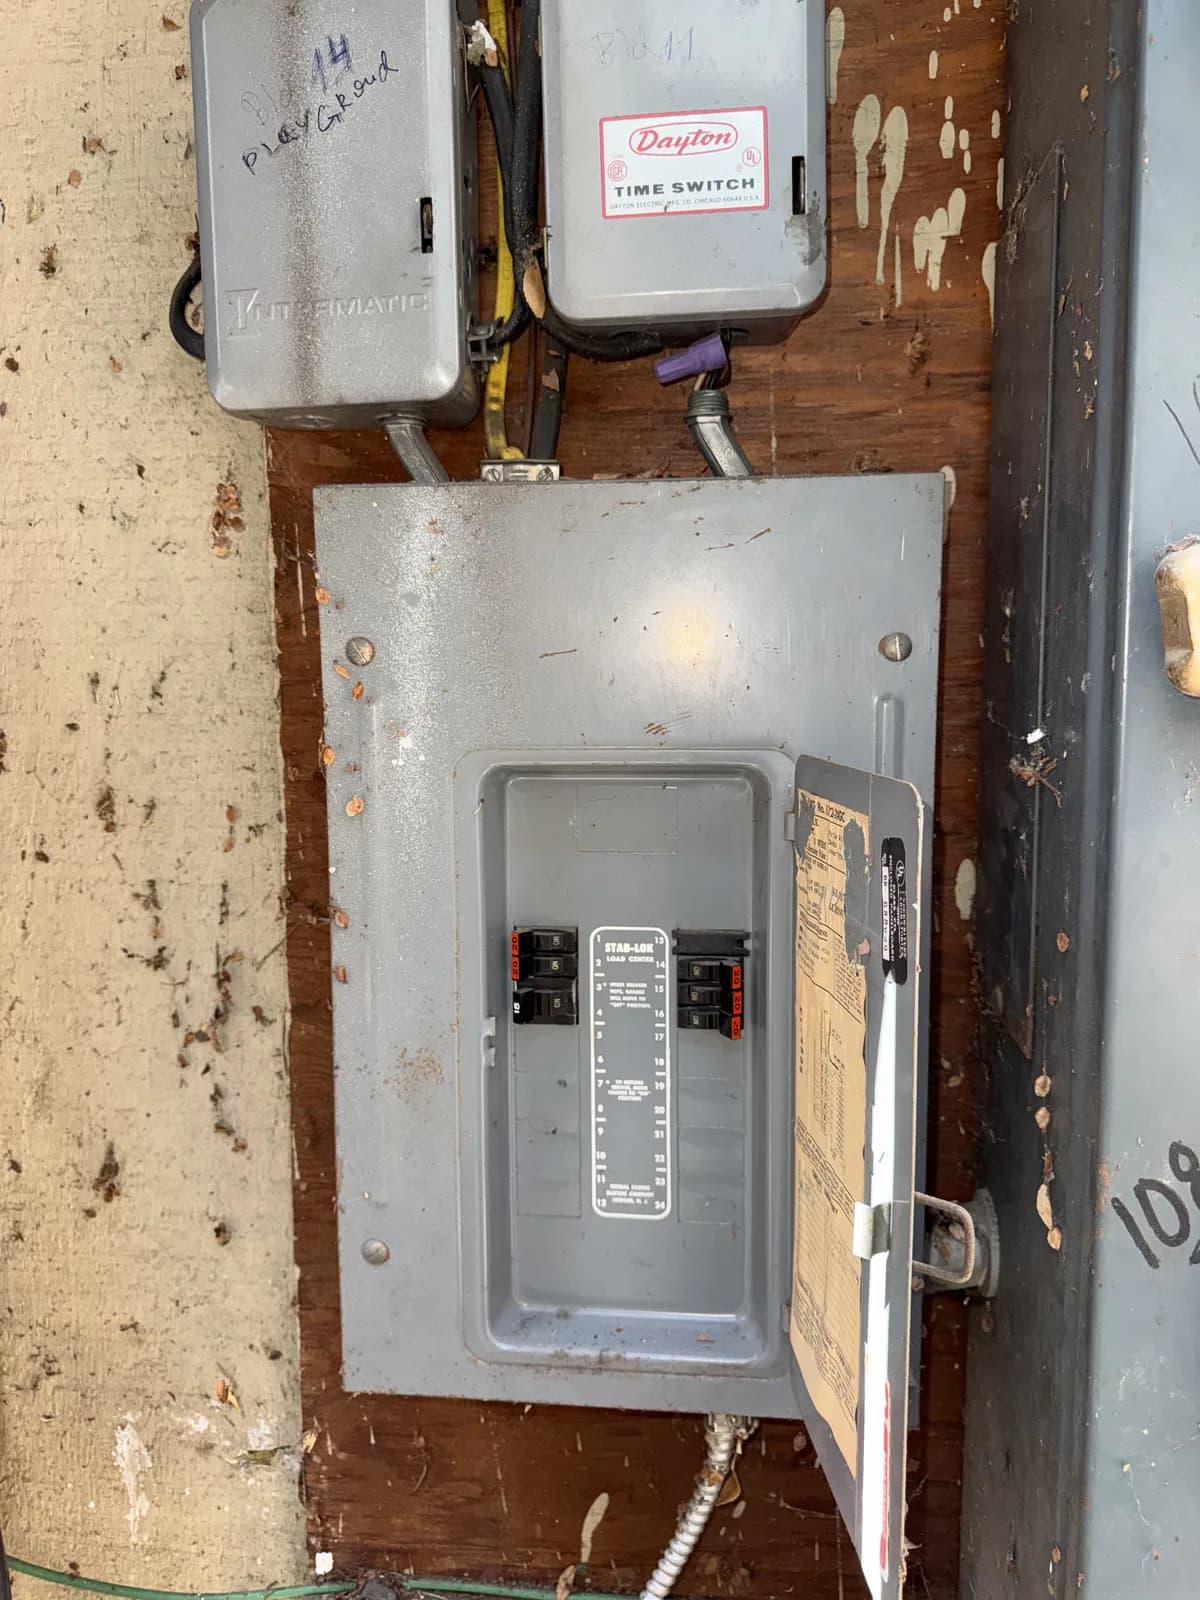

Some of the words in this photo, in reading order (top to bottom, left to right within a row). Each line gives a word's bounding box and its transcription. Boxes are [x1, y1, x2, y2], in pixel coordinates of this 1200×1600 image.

[637, 128, 732, 155] Dayton
[614, 184, 665, 198] TIME
[672, 178, 755, 194] SWITCH
[610, 202, 635, 210] DAYTON
[636, 199, 665, 209] ELECTRIC
[551, 936, 560, 946] ON
[596, 934, 601, 942] 1
[654, 936, 664, 945] 13
[604, 942, 654, 953] STAB-LOK
[551, 960, 560, 970] ON
[595, 958, 602, 967] 2
[655, 961, 665, 969] 14
[733, 969, 740, 984] 20
[595, 983, 602, 991] 3
[654, 984, 664, 993] 15
[734, 995, 741, 1010] 20
[513, 1002, 520, 1014] 15
[596, 1008, 603, 1016] 4
[654, 1009, 665, 1018] 16
[596, 1031, 603, 1039] 5
[654, 1033, 664, 1041] 17
[597, 1055, 604, 1063] 6
[654, 1058, 665, 1066] 18
[597, 1079, 604, 1088] 7
[654, 1082, 665, 1090] 19
[597, 1104, 604, 1112] 8
[653, 1106, 665, 1114] 20
[597, 1127, 604, 1136] 9
[653, 1130, 664, 1139] 21
[596, 1151, 607, 1160] 10
[653, 1154, 665, 1163] 22
[596, 1174, 606, 1183] 11
[654, 1201, 665, 1210] 24
